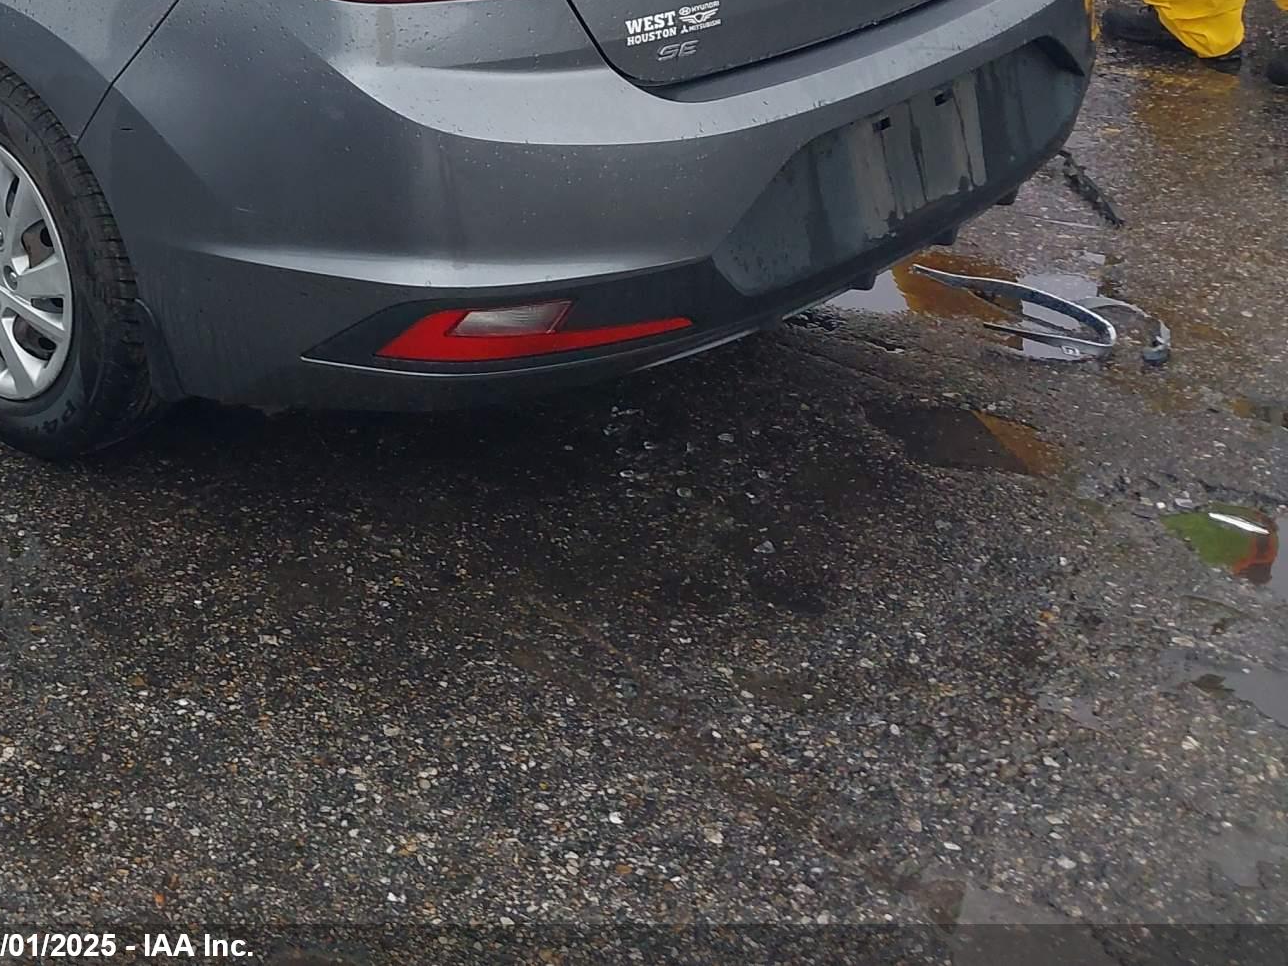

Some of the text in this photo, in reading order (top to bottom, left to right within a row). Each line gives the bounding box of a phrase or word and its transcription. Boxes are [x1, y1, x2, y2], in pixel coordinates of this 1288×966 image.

[691, 0, 720, 12] HYUNDAI
[624, 10, 676, 35] WEST
[689, 19, 722, 32] MITSUBISHI
[626, 26, 678, 47] HOUSTON
[657, 39, 699, 62] SE
